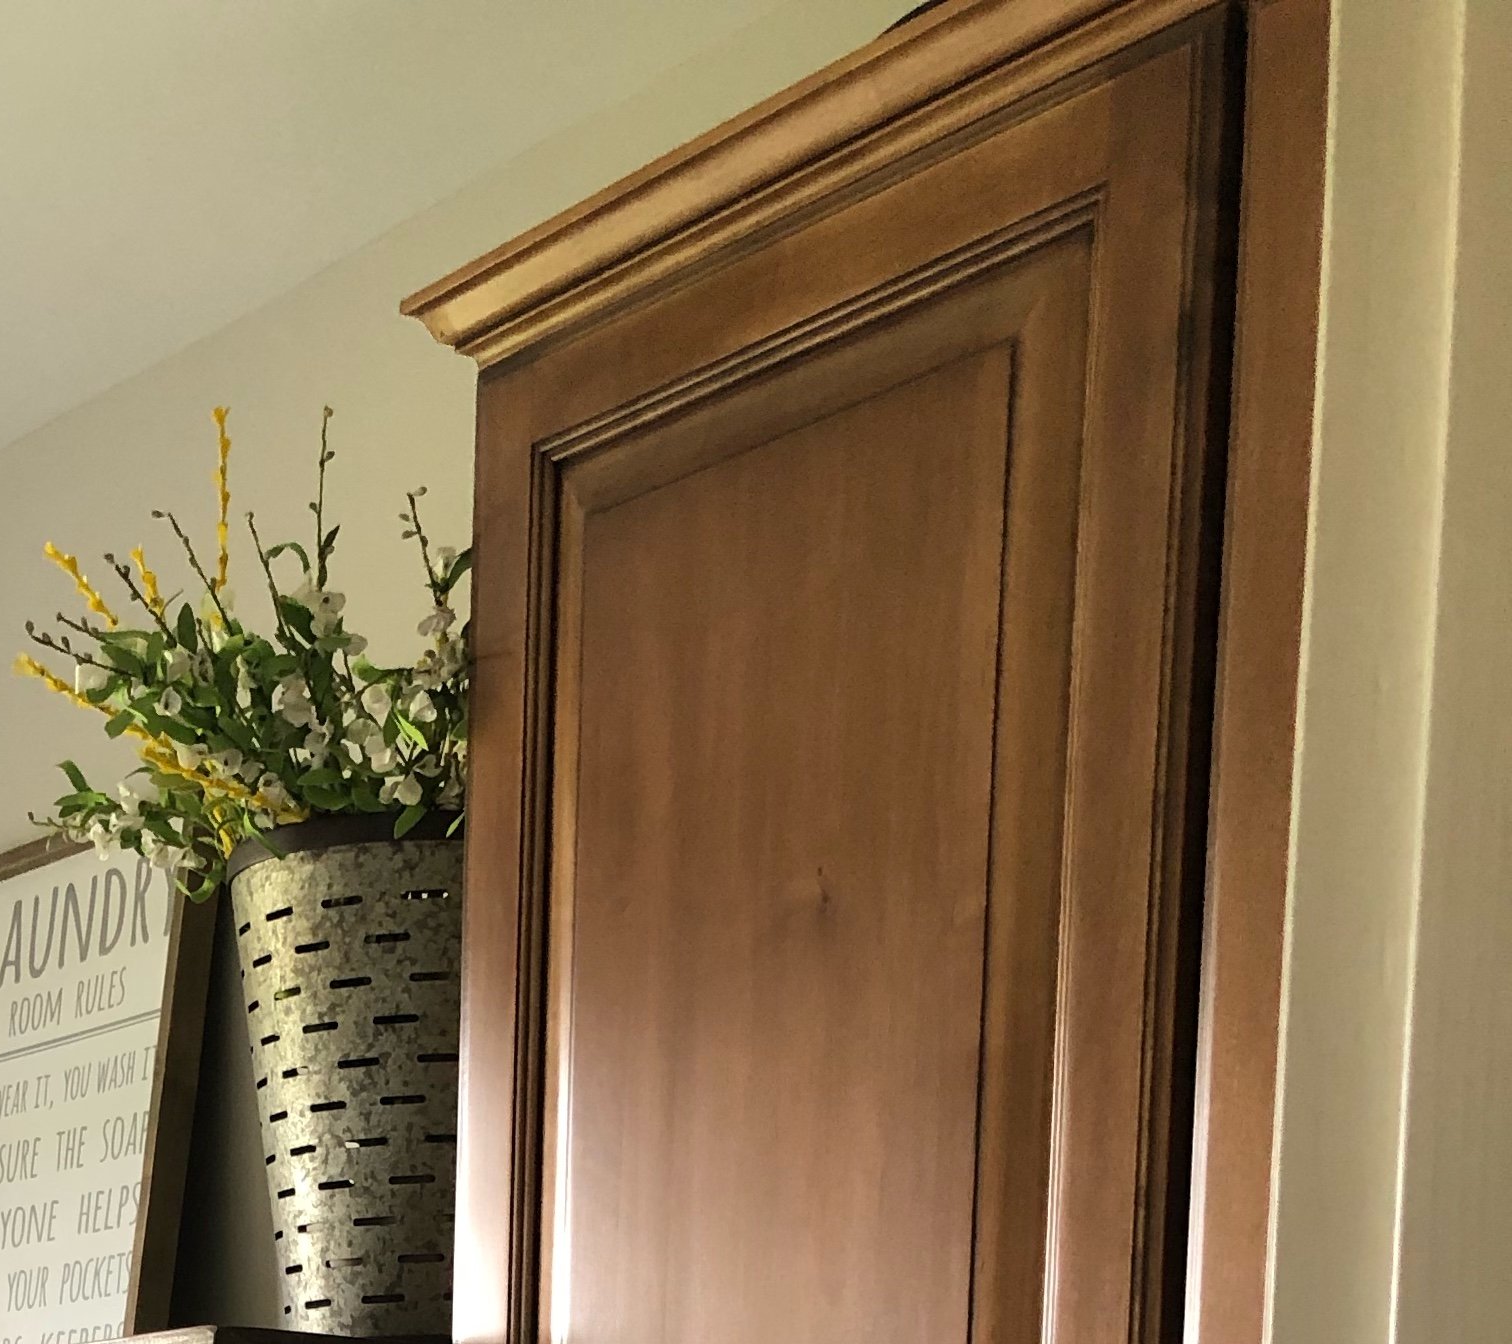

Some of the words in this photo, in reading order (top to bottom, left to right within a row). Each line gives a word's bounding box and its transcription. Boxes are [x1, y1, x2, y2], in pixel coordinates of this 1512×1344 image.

[8, 988, 63, 1038] ROOM
[75, 966, 127, 1018] RULES
[34, 1074, 54, 1110] IT,
[64, 1062, 92, 1102] YOU
[97, 1050, 136, 1095] WASH
[142, 1045, 157, 1081] I
[56, 1126, 88, 1172] THE
[7, 1266, 49, 1312] YOUR
